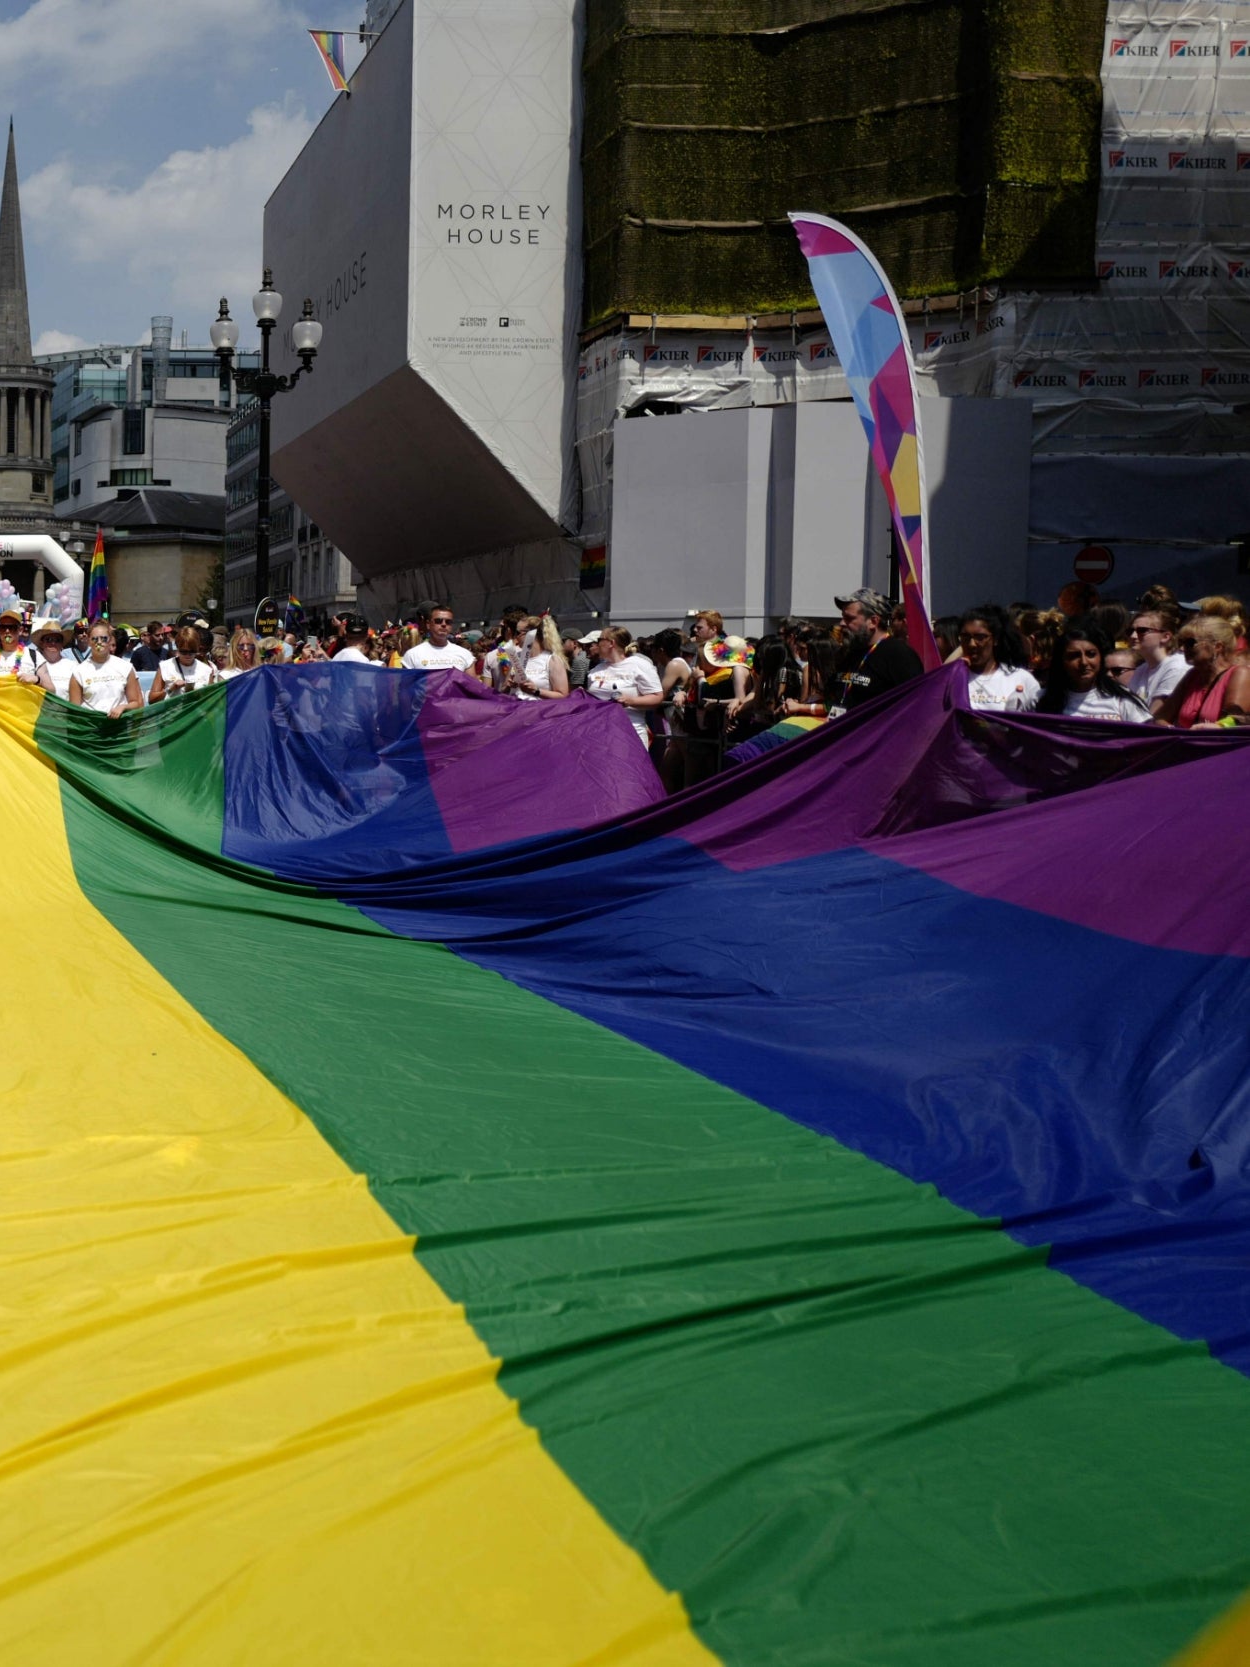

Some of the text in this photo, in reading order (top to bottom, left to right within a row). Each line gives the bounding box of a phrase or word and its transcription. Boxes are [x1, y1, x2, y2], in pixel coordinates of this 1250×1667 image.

[1127, 45, 1158, 56] KIER
[1187, 45, 1221, 56] KIER
[1125, 157, 1158, 168] KIER
[437, 204, 550, 220] MORLEY
[448, 228, 539, 244] HOUSE
[1116, 266, 1148, 277] KIER
[327, 251, 367, 320] HOUSE
[941, 331, 970, 345] KIER
[659, 350, 689, 360] KIER
[713, 351, 743, 361] KIER
[768, 351, 797, 361] KIER
[1033, 375, 1067, 386] KIER
[1097, 376, 1126, 386] KIER
[1155, 374, 1189, 386] KIER
[1217, 373, 1250, 385] KIER
[4, 542, 14, 550] IN
